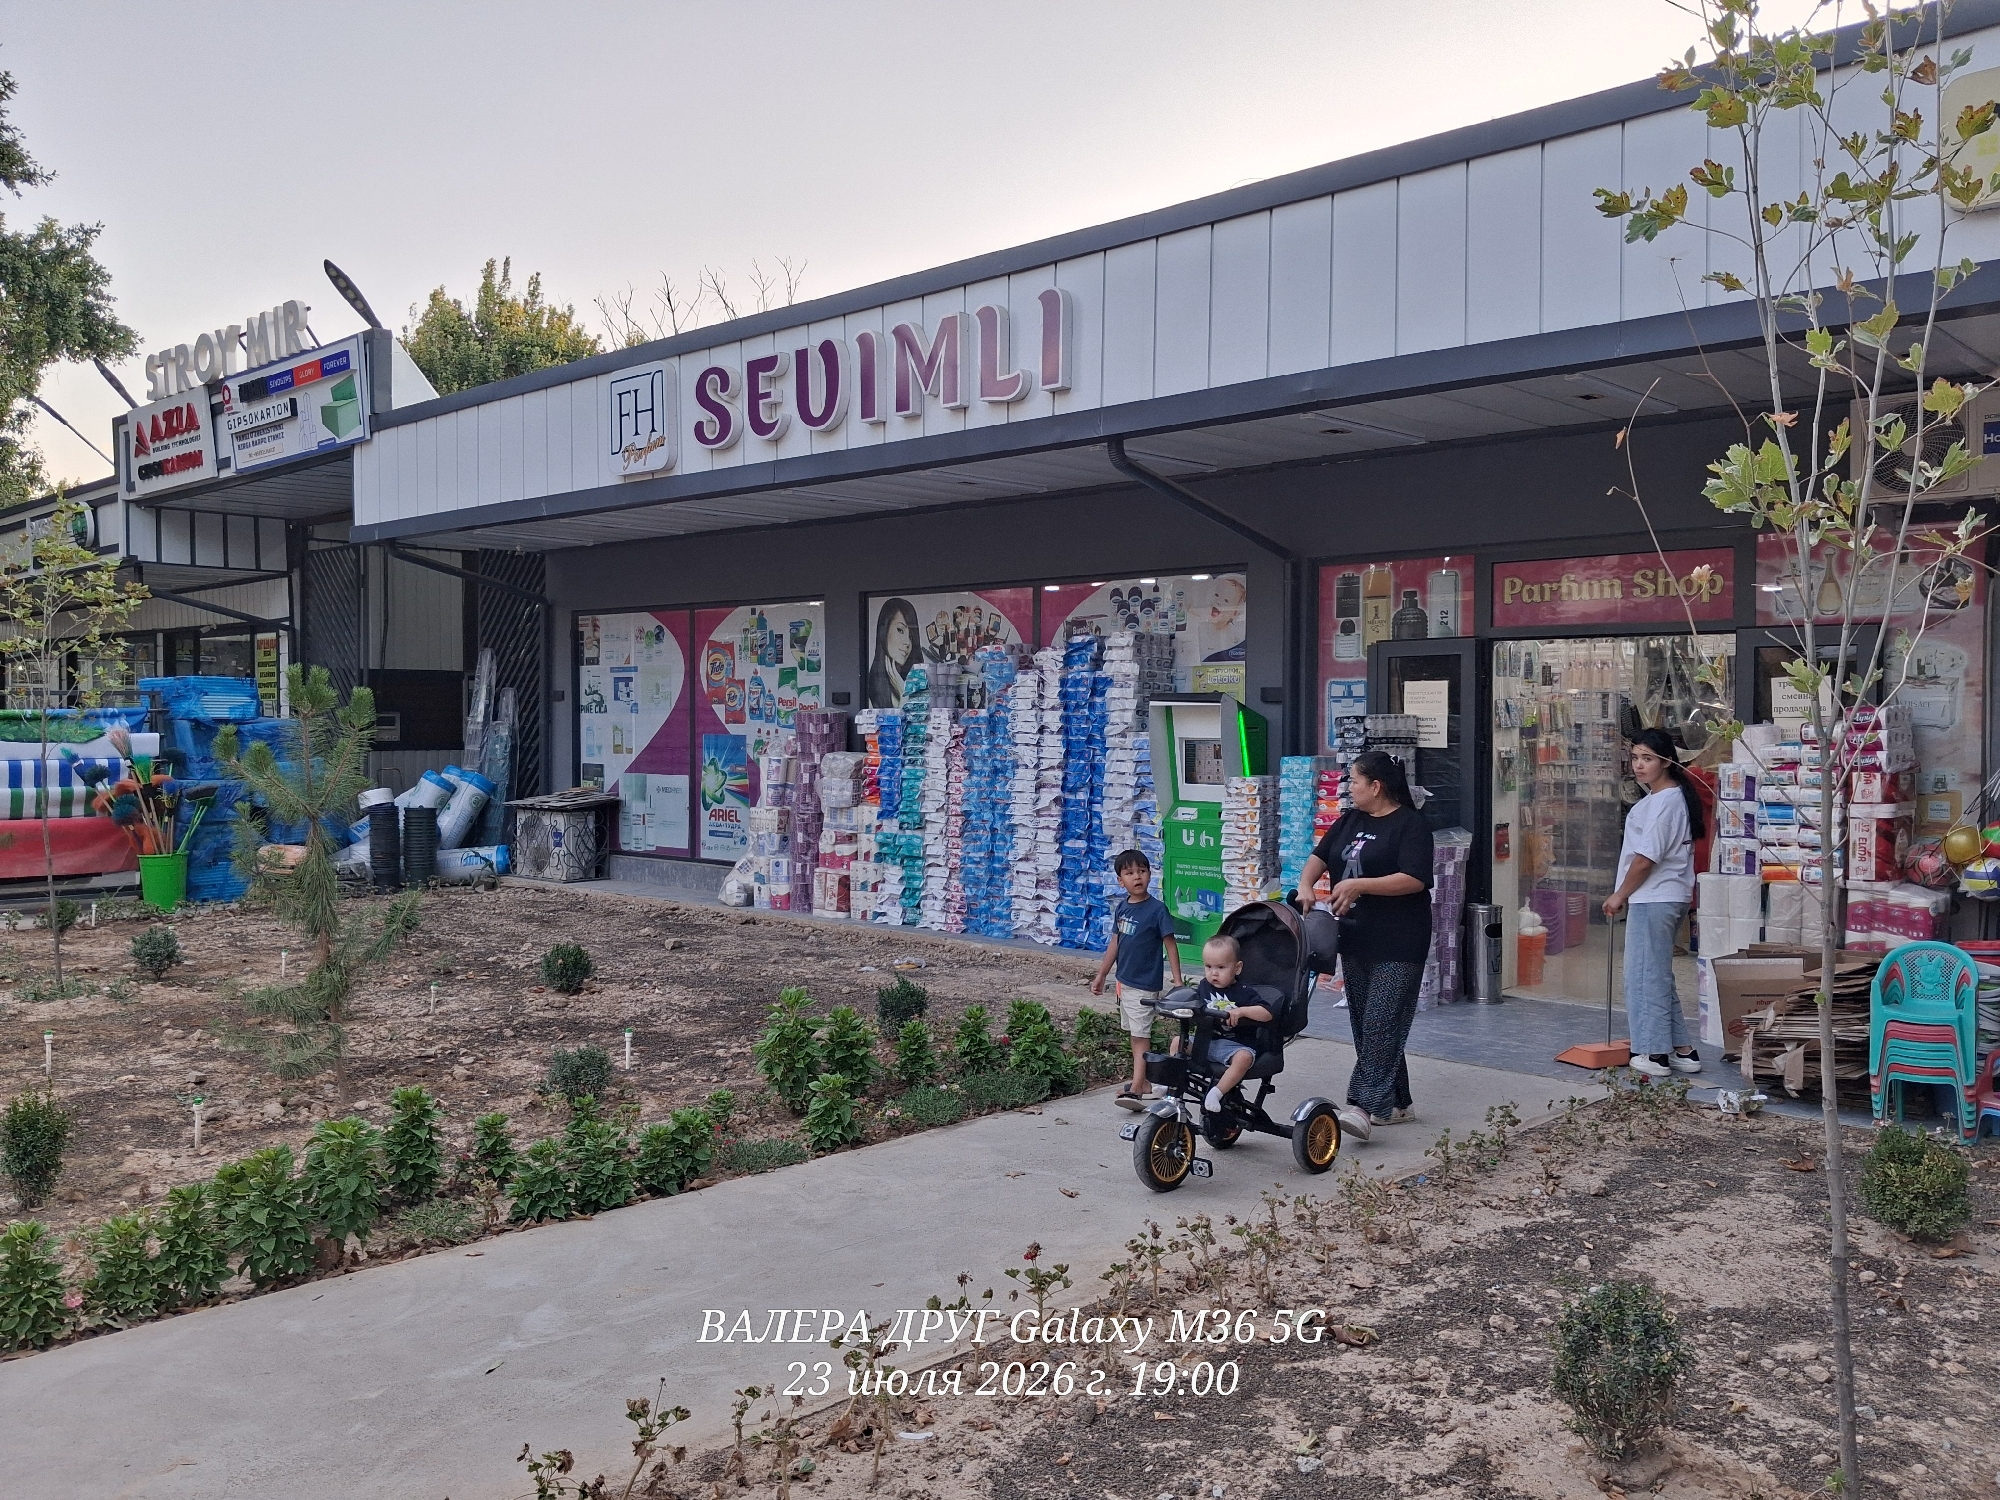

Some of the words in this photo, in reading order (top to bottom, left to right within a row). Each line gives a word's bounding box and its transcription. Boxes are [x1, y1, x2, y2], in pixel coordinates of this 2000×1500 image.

[146, 325, 241, 401] STROY
[247, 300, 312, 368] MIR
[323, 356, 347, 371] FOREVER
[1503, 573, 1624, 605] Parfum
[1632, 567, 1725, 604] Shop
[1440, 609, 1449, 626] 212
[709, 661, 725, 675] Tide
[727, 693, 738, 702] Tide
[778, 697, 797, 707] Persil
[708, 808, 741, 823] ARIEL
[1858, 836, 1871, 863] ELMA
